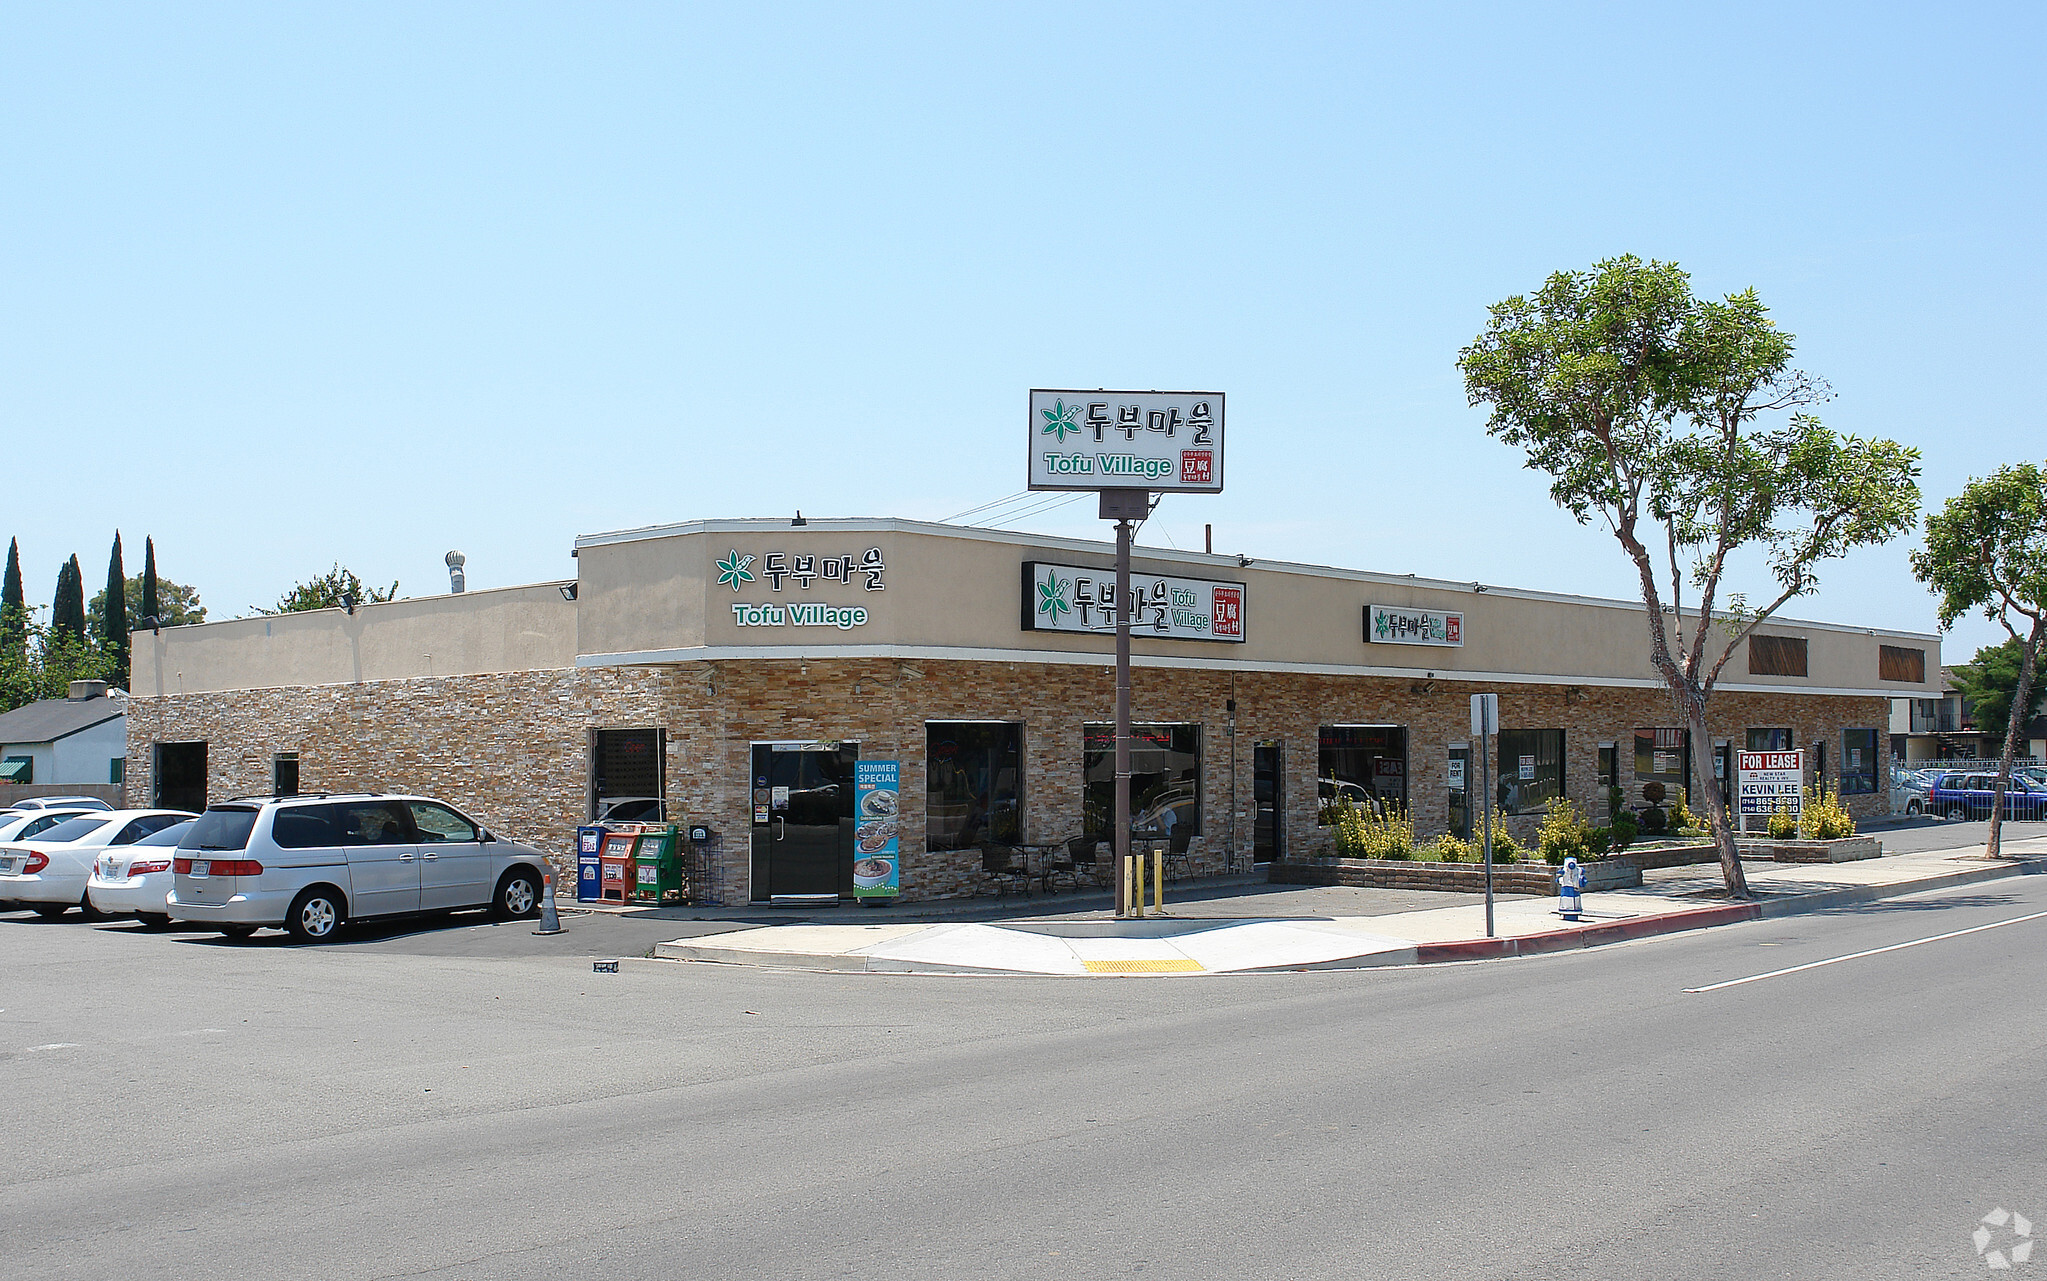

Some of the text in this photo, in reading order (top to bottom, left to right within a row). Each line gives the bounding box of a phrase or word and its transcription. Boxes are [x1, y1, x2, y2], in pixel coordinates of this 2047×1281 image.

[1084, 401, 1214, 446] 두부마을
[1044, 453, 1173, 479] Tofu Village
[762, 547, 886, 592] 두부마을
[1073, 577, 1170, 632] 두부마을
[1170, 588, 1197, 607] Tofu
[733, 605, 867, 629] Tofu Village
[1171, 609, 1209, 631] Village
[1389, 613, 1430, 641] 두부마을
[858, 764, 897, 773] SUMMER
[1742, 754, 1797, 769] FOR LEASE
[858, 773, 897, 783] SPECIAL
[1450, 769, 1462, 777] RENT
[1742, 784, 1798, 795] KEVIN LEE
